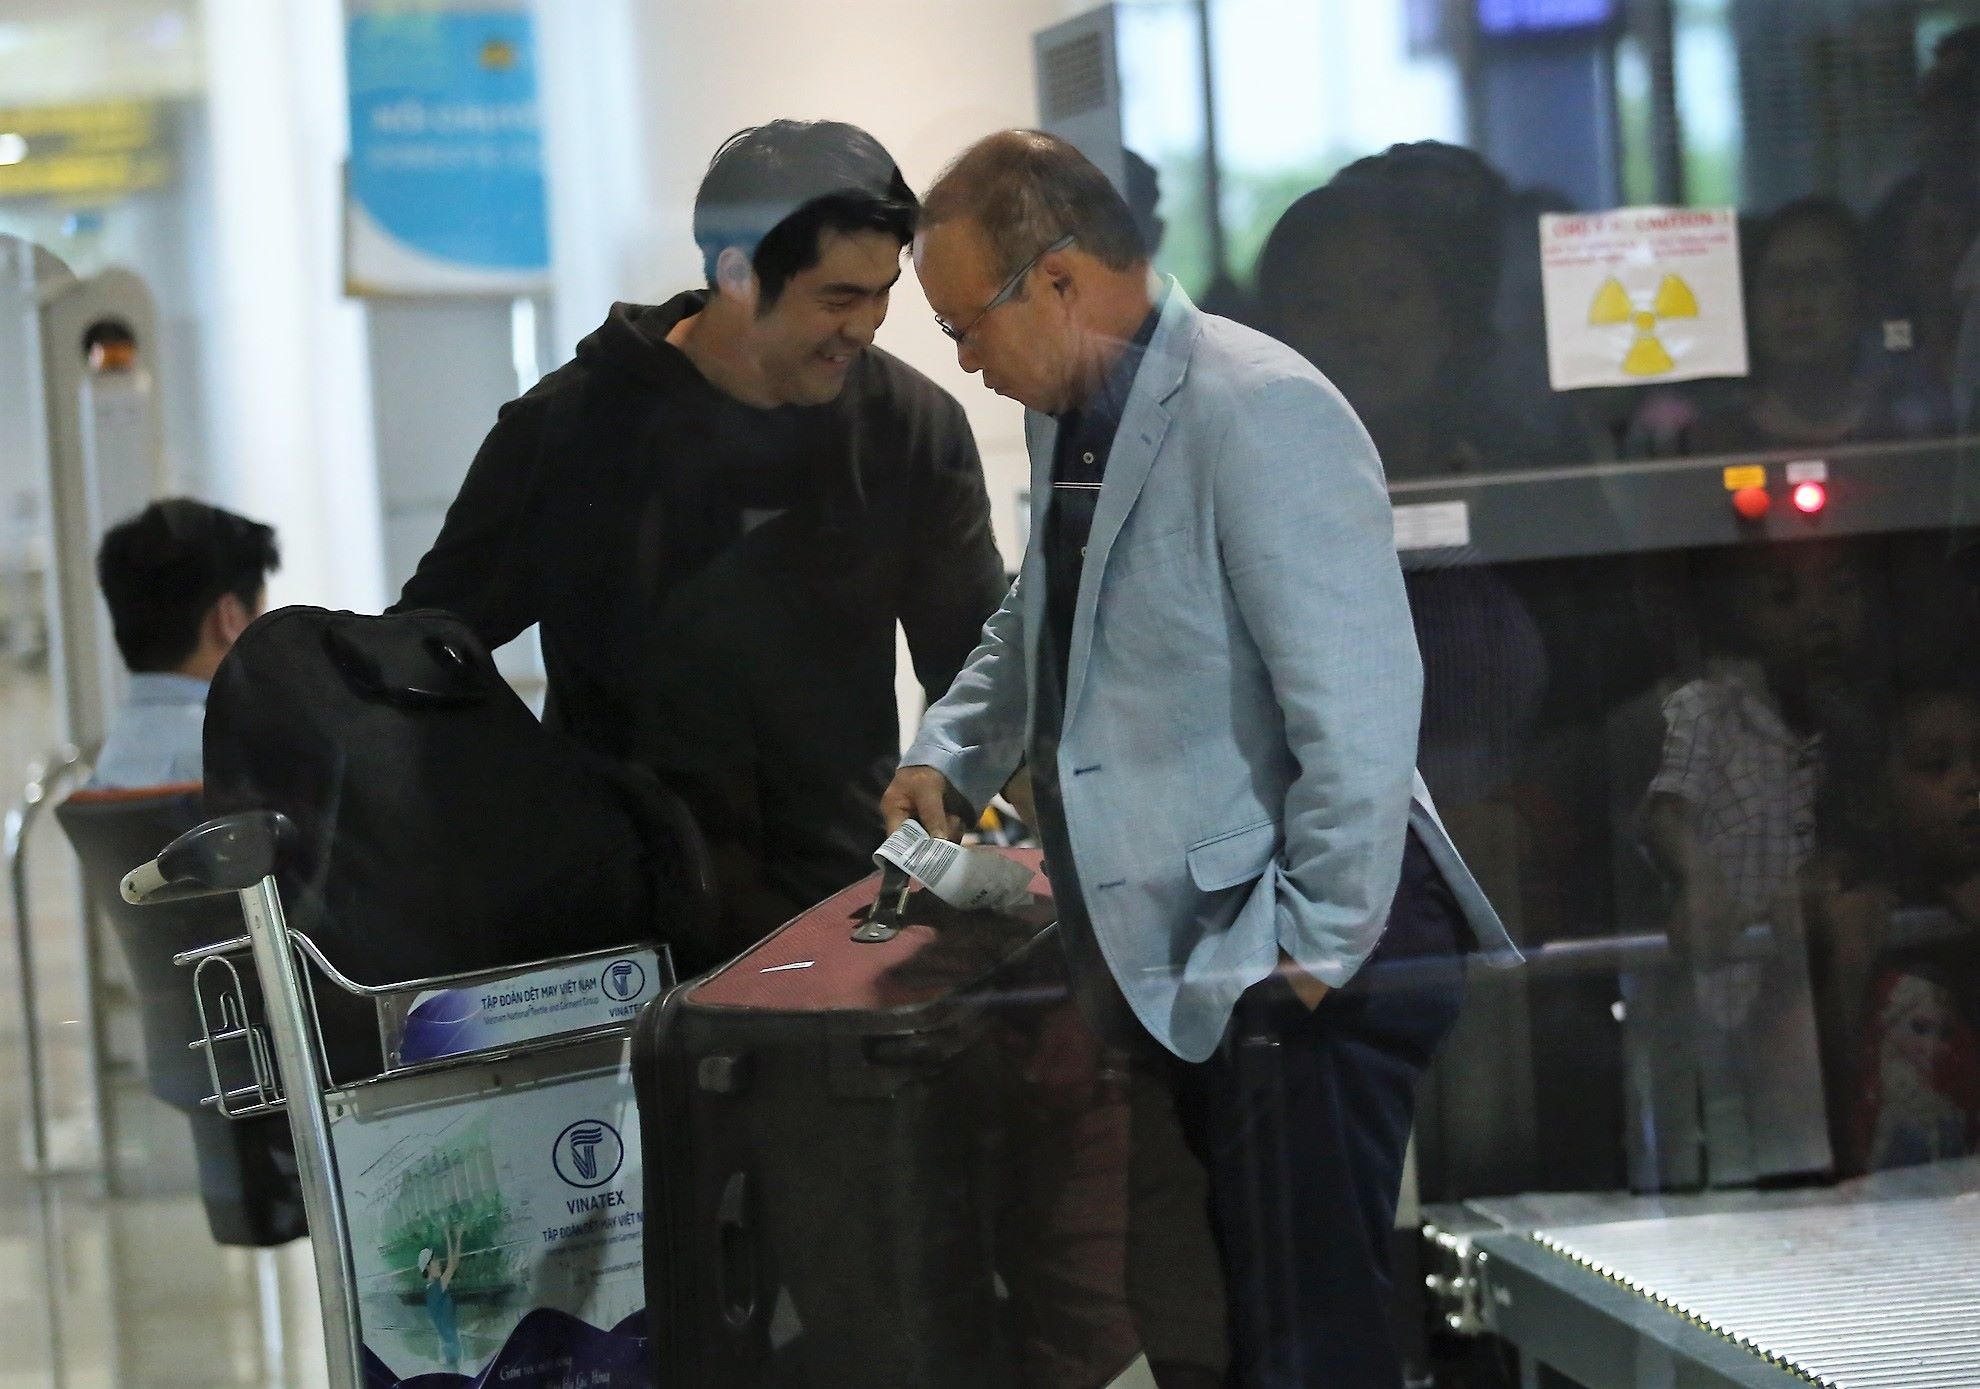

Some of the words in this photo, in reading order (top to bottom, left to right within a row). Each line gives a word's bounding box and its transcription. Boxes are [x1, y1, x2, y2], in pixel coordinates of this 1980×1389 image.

[500, 991, 523, 1007] ĐOÀN
[541, 985, 557, 999] MAY
[579, 978, 597, 991] NAM
[609, 1004, 640, 1017] VINATE
[567, 1190, 625, 1215] VINATEX
